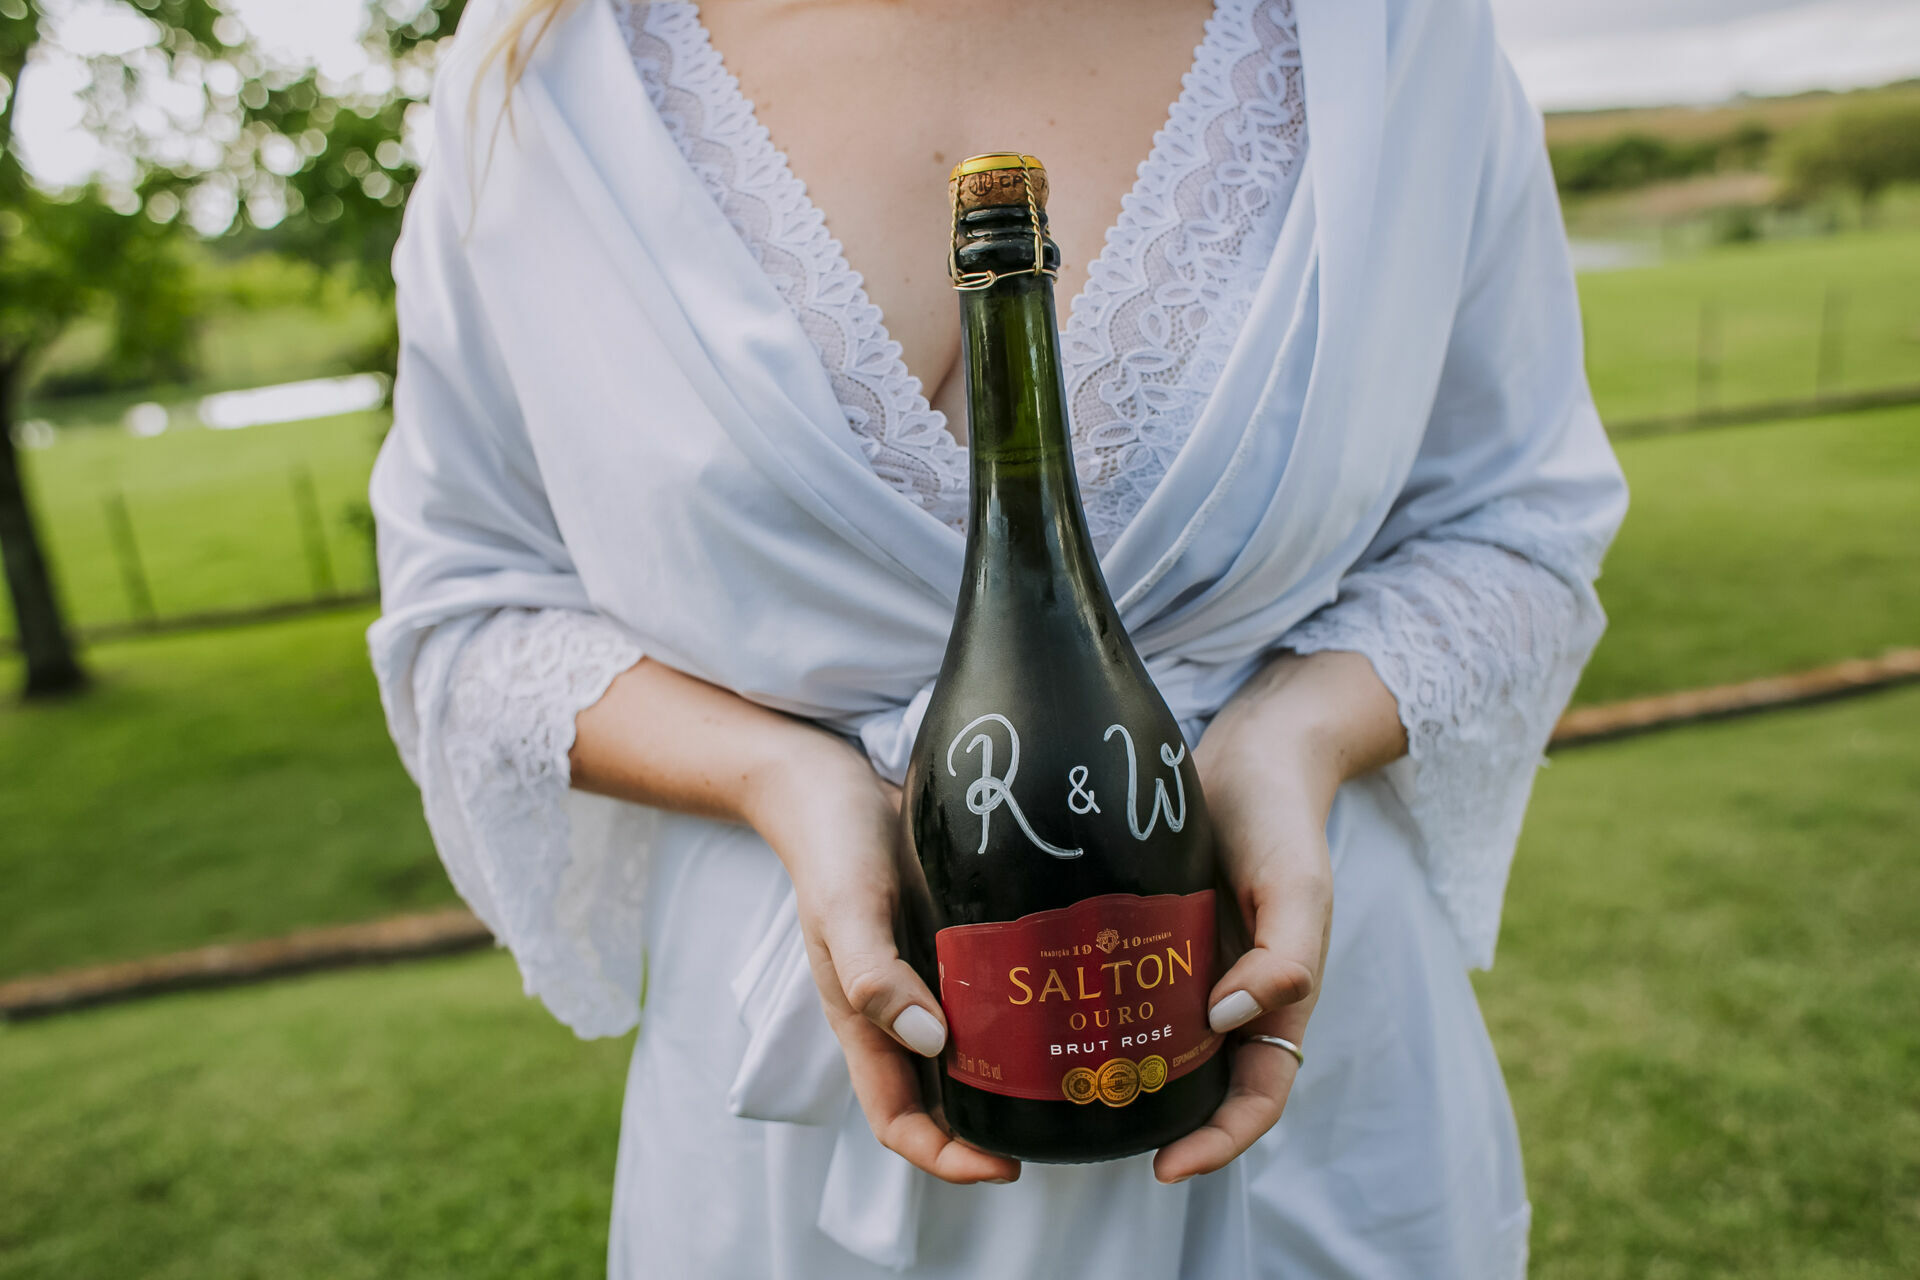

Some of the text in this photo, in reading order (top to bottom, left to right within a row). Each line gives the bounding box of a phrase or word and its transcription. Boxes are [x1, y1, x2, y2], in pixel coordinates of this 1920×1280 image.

[947, 713, 1186, 859] R & W
[1122, 936, 1142, 949] 10
[1007, 939, 1193, 1006] SALTON
[1069, 1001, 1155, 1031] OURO
[1050, 1024, 1174, 1056] BRUT ROSÉ
